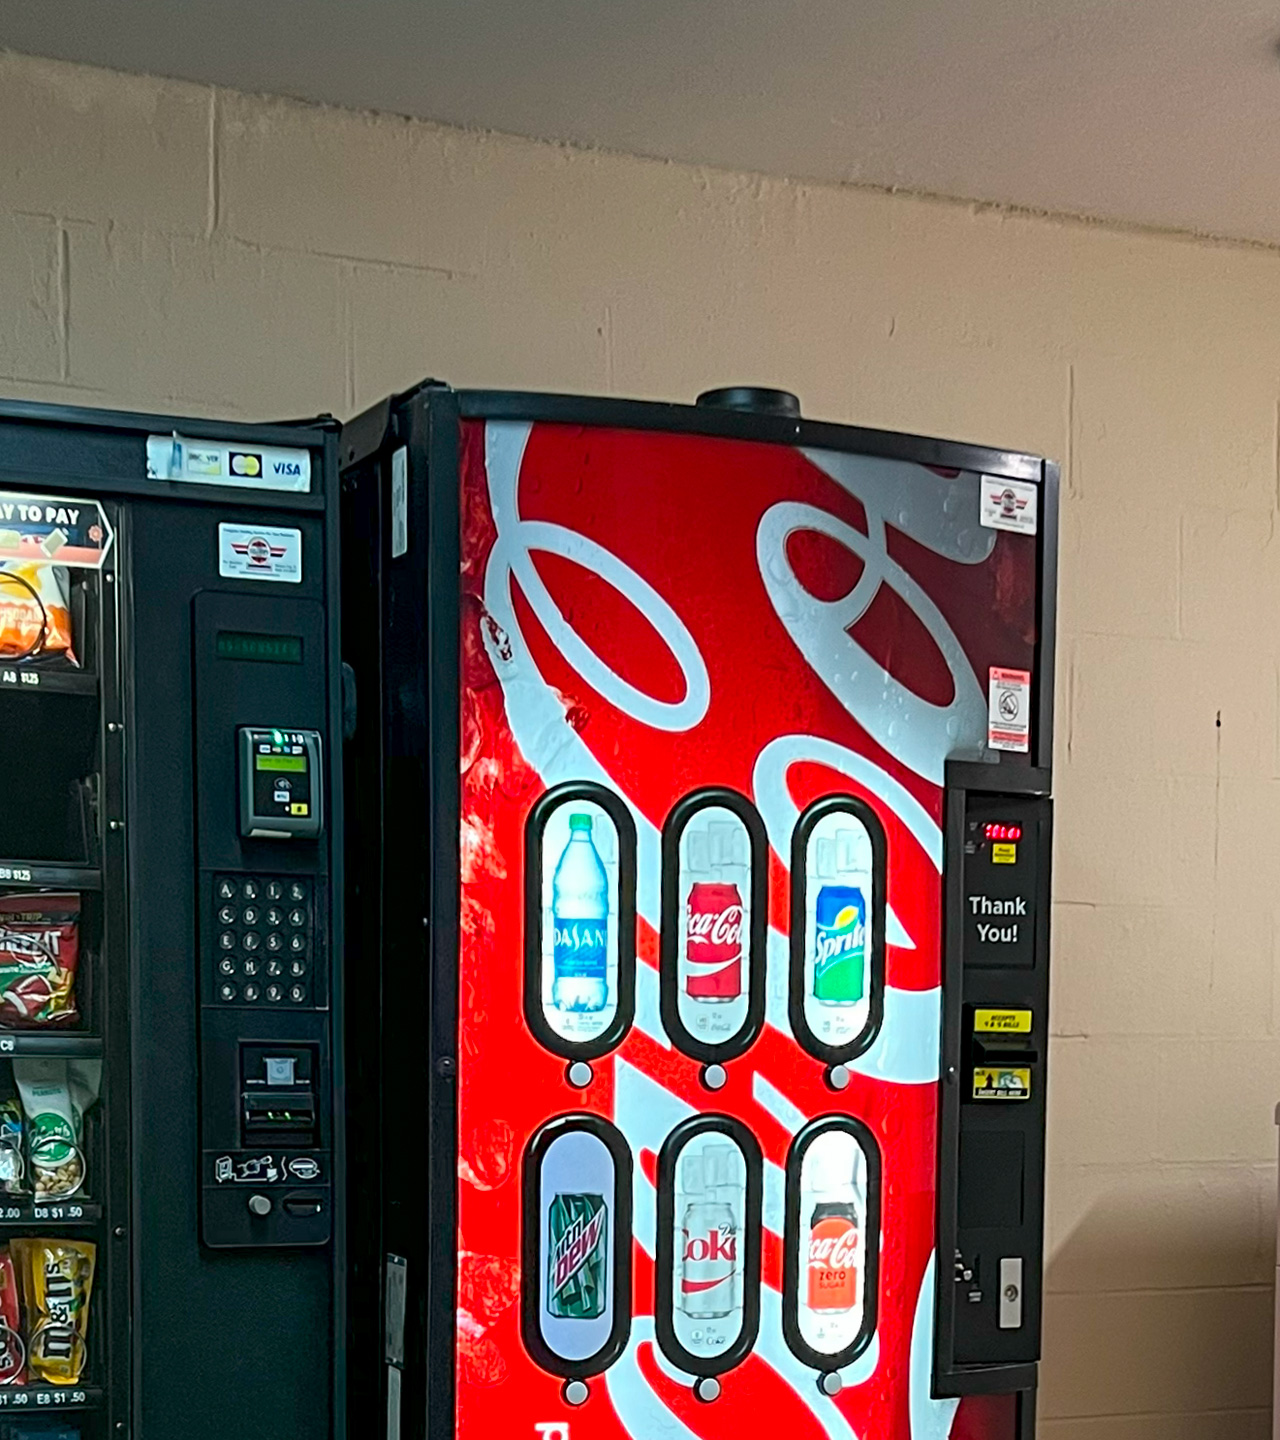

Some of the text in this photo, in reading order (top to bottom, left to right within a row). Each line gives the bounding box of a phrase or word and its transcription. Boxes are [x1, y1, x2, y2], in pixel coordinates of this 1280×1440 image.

[273, 462, 301, 476] VISA
[18, 504, 41, 522] TO
[45, 507, 80, 526] PAY
[969, 896, 1026, 915] Thank
[976, 923, 1018, 942] You!
[34, 1208, 50, 1218] D8
[820, 1271, 846, 1281] zero
[36, 1394, 51, 1404] E8
